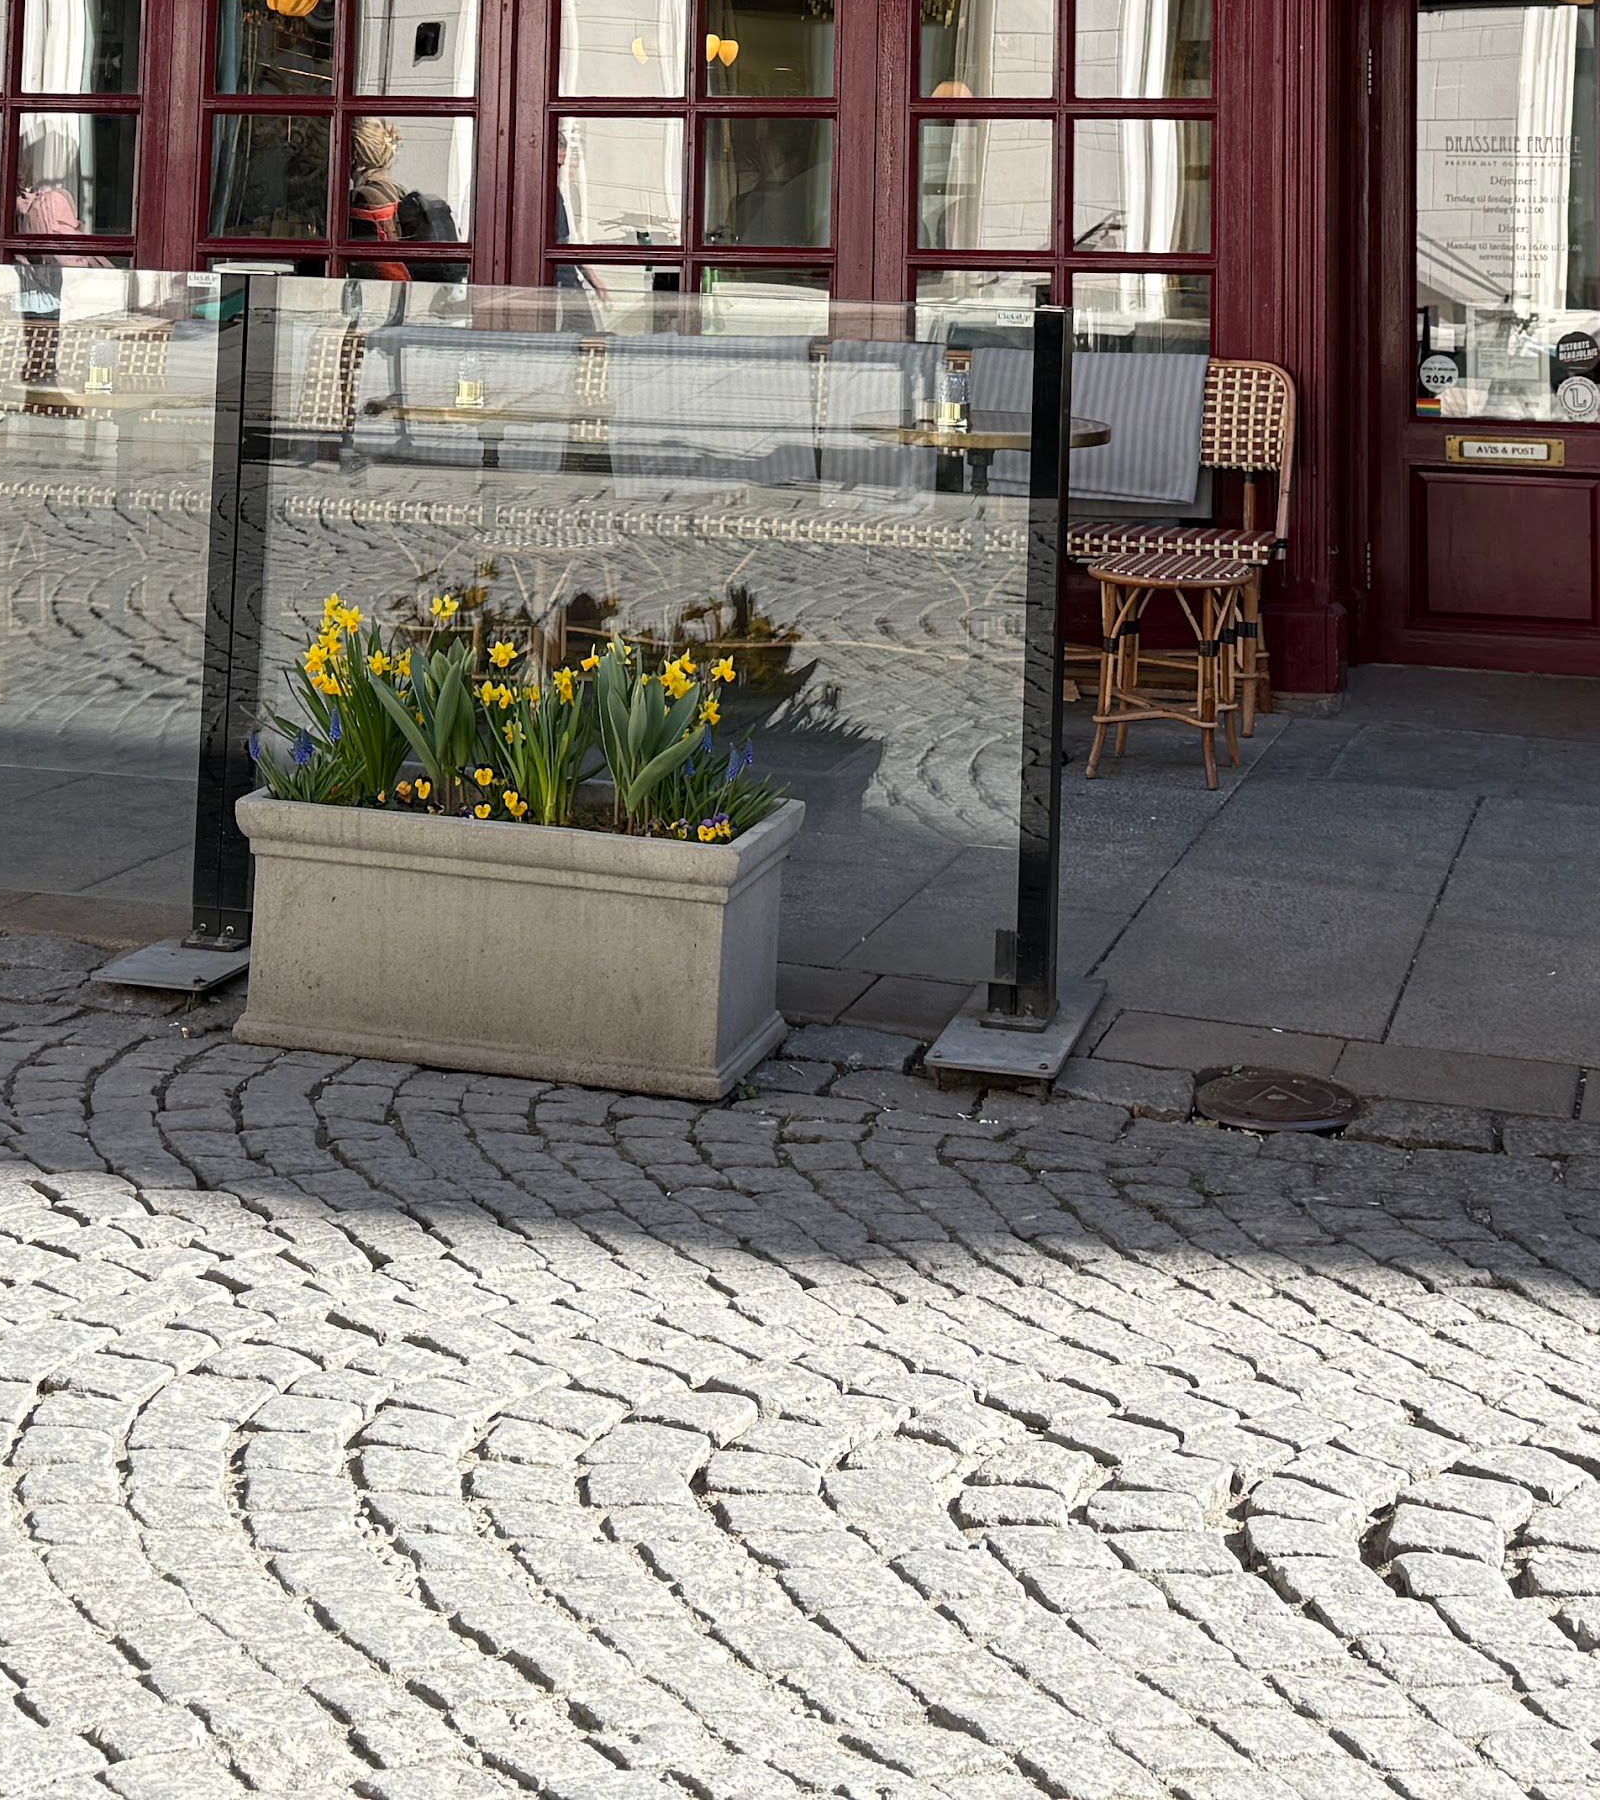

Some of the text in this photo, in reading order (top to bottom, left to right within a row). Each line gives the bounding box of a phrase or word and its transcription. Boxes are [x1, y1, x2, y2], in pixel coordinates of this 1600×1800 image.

[1445, 136, 1582, 153] BRASSERIE FRANCE
[1425, 375, 1453, 384] 2024
[1476, 445, 1499, 454] AVIS
[1511, 446, 1535, 455] POST
